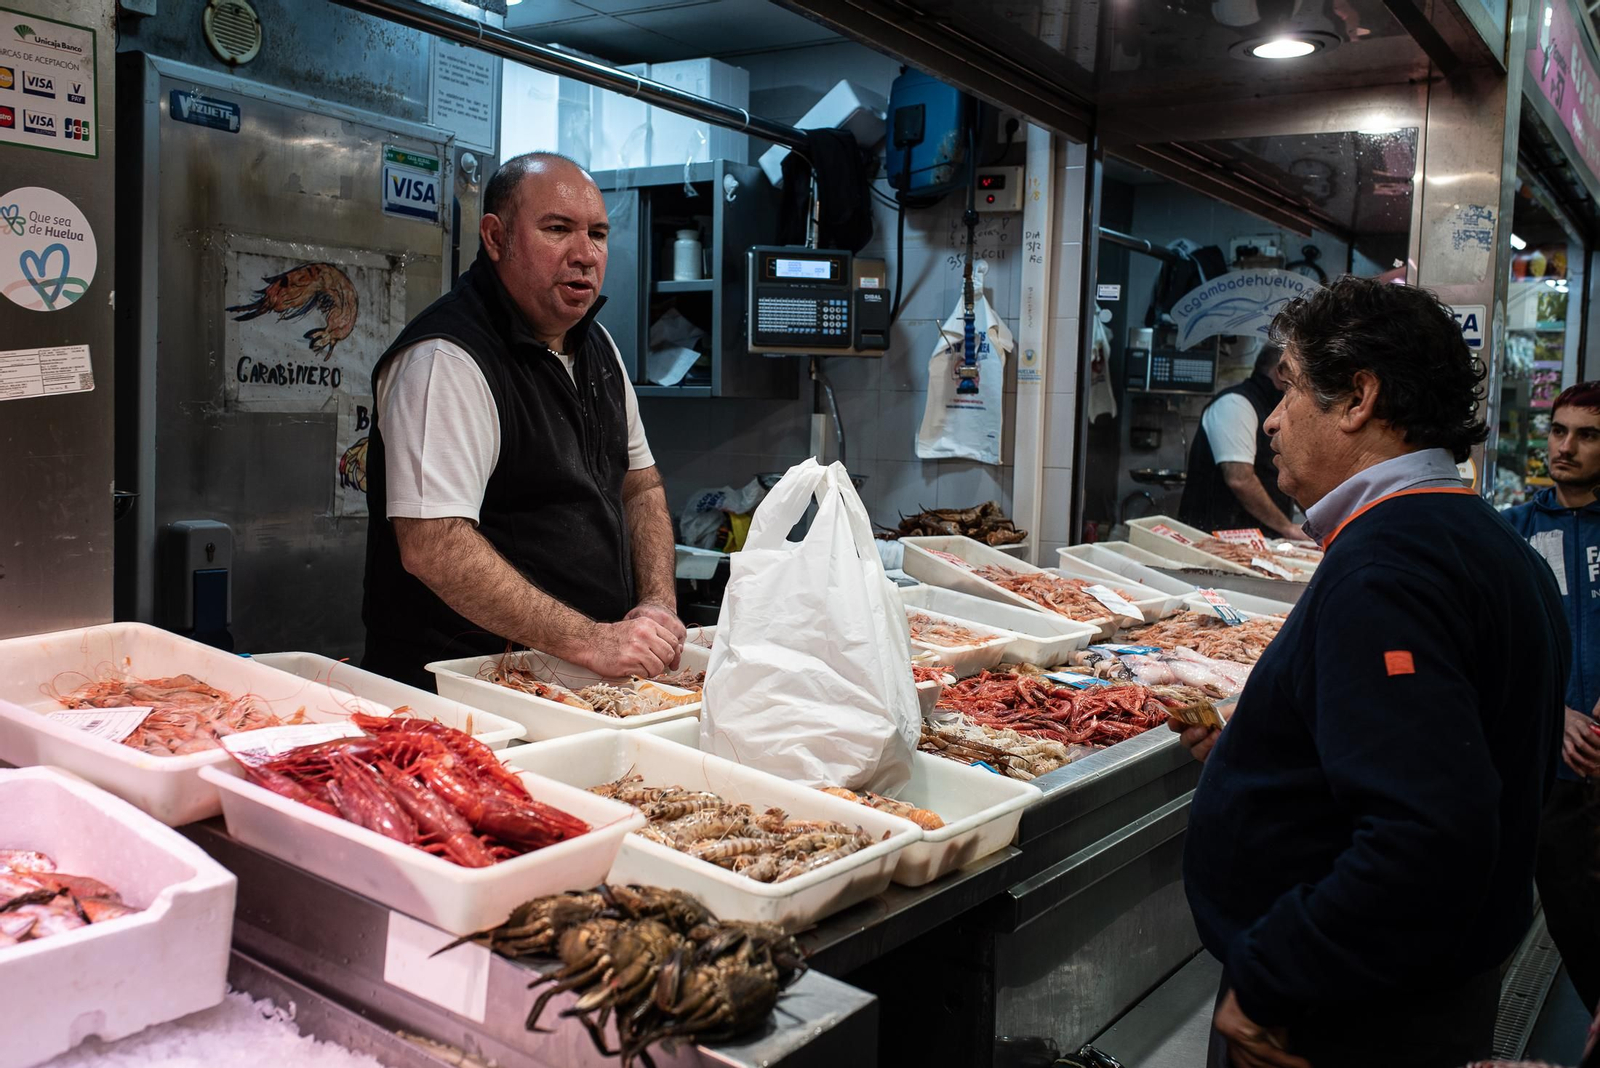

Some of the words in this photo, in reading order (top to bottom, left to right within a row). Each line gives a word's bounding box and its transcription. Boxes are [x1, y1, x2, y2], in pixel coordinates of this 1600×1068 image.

[34, 36, 61, 49] Unicaja
[61, 42, 83, 53] Banco
[23, 53, 33, 62] DE
[34, 56, 80, 71] ACEPTACIÓN
[26, 74, 54, 90] VISA
[27, 113, 55, 128] VISA
[65, 124, 89, 135] JCB
[391, 174, 436, 205] VISA
[28, 210, 51, 225] Que
[53, 214, 72, 227] sea
[28, 223, 43, 236] de
[44, 227, 84, 242] Huelva
